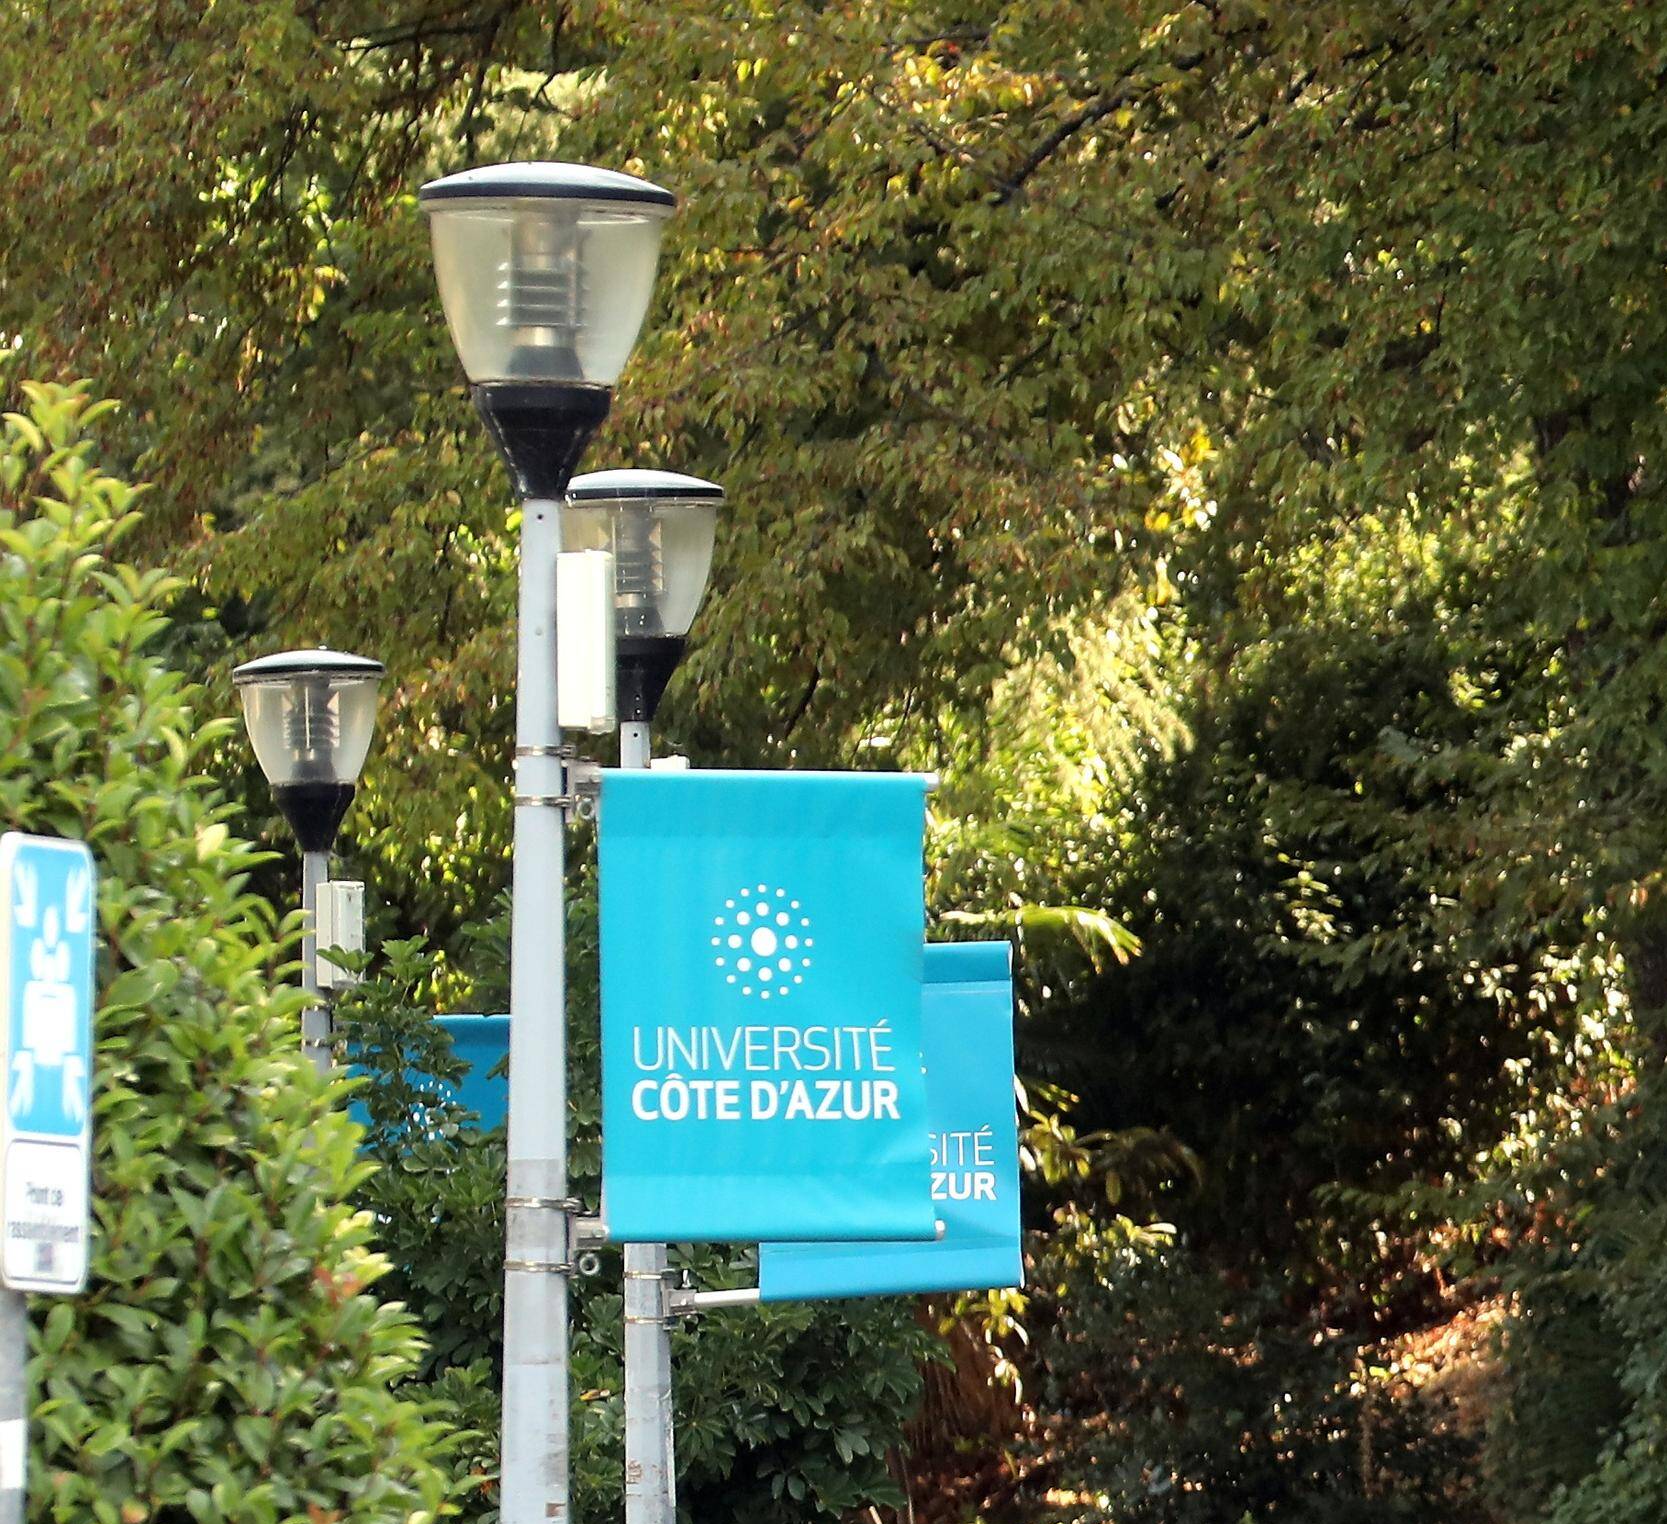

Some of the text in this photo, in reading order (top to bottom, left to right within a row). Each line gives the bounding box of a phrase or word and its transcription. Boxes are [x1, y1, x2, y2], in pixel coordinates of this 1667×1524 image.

[633, 1018, 896, 1072] UNIVERSITÉ
[631, 1072, 901, 1121] CÔTE D'AZUR
